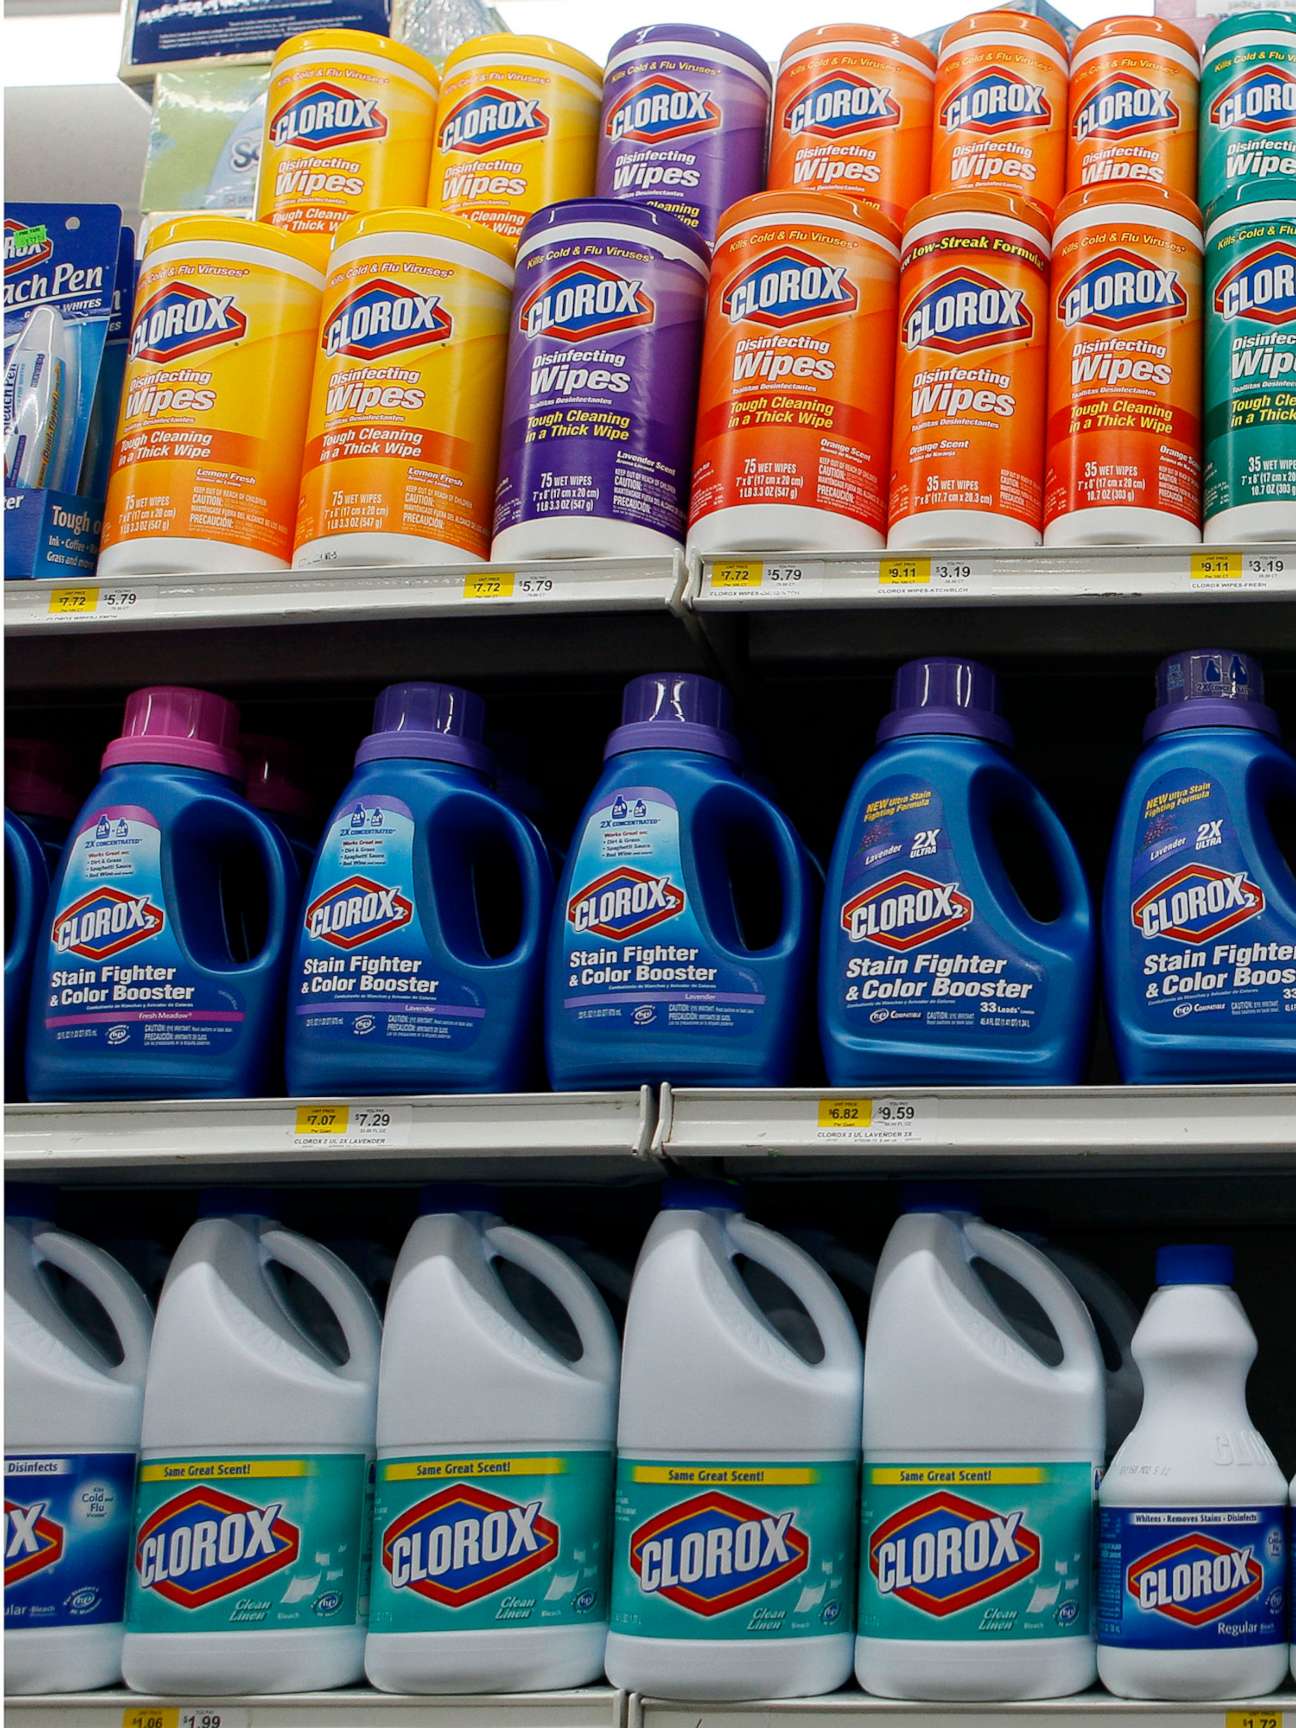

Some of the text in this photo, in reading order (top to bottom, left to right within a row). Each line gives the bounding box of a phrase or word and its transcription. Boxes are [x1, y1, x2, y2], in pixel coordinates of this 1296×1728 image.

[610, 89, 711, 142] CLOROX
[789, 84, 892, 137] CLOROX
[945, 82, 1044, 135] CLOROX
[1076, 88, 1173, 142] CLOROX
[272, 100, 375, 146] CLOROX
[440, 100, 537, 145] CLOROX
[912, 237, 989, 262] Low-Streak
[1216, 236, 1236, 250] Kills
[1239, 229, 1265, 244] Cold
[1268, 227, 1276, 236] &
[52, 268, 101, 297] Pen
[730, 266, 847, 323] CLOROX
[63, 297, 101, 311] WHITES
[526, 280, 643, 339] CLOROX
[1064, 270, 1179, 326] CLOROX
[129, 297, 238, 360] CLOROX
[326, 296, 440, 357] CLOROX
[905, 289, 1024, 350] CLOROX
[532, 350, 626, 368] Disinfecting
[128, 371, 212, 393] Disinfecting
[529, 366, 631, 396] Wipes
[125, 388, 216, 416] Wipes
[1232, 396, 1271, 414] Tough
[1231, 414, 1242, 427] in
[1244, 416, 1253, 424] a
[1248, 457, 1261, 471] 35
[1263, 460, 1281, 470] WET
[52, 507, 91, 534] Tough
[910, 844, 938, 858] ULTRA
[914, 830, 940, 847] 2X
[52, 966, 176, 987] Stain Fighter
[846, 958, 1006, 977] Stain Fighter
[51, 985, 194, 1007] & Color Booster
[846, 979, 1032, 1001] & Color Booster
[8, 1461, 57, 1473] Disinfects
[164, 1463, 251, 1477] Same Great Scent!
[1136, 1514, 1163, 1523] Whitens
[1168, 1514, 1198, 1523] Removes
[1201, 1514, 1222, 1523] Stains
[139, 1504, 283, 1588] CLOROX
[391, 1502, 543, 1588] CLOROX
[640, 1513, 794, 1593] CLOROX
[877, 1512, 1023, 1594] CLOROX
[1139, 1547, 1254, 1610] CLOROX
[229, 1610, 265, 1622] Linen
[235, 1599, 271, 1611] Clean
[1217, 1621, 1257, 1636] Regular
